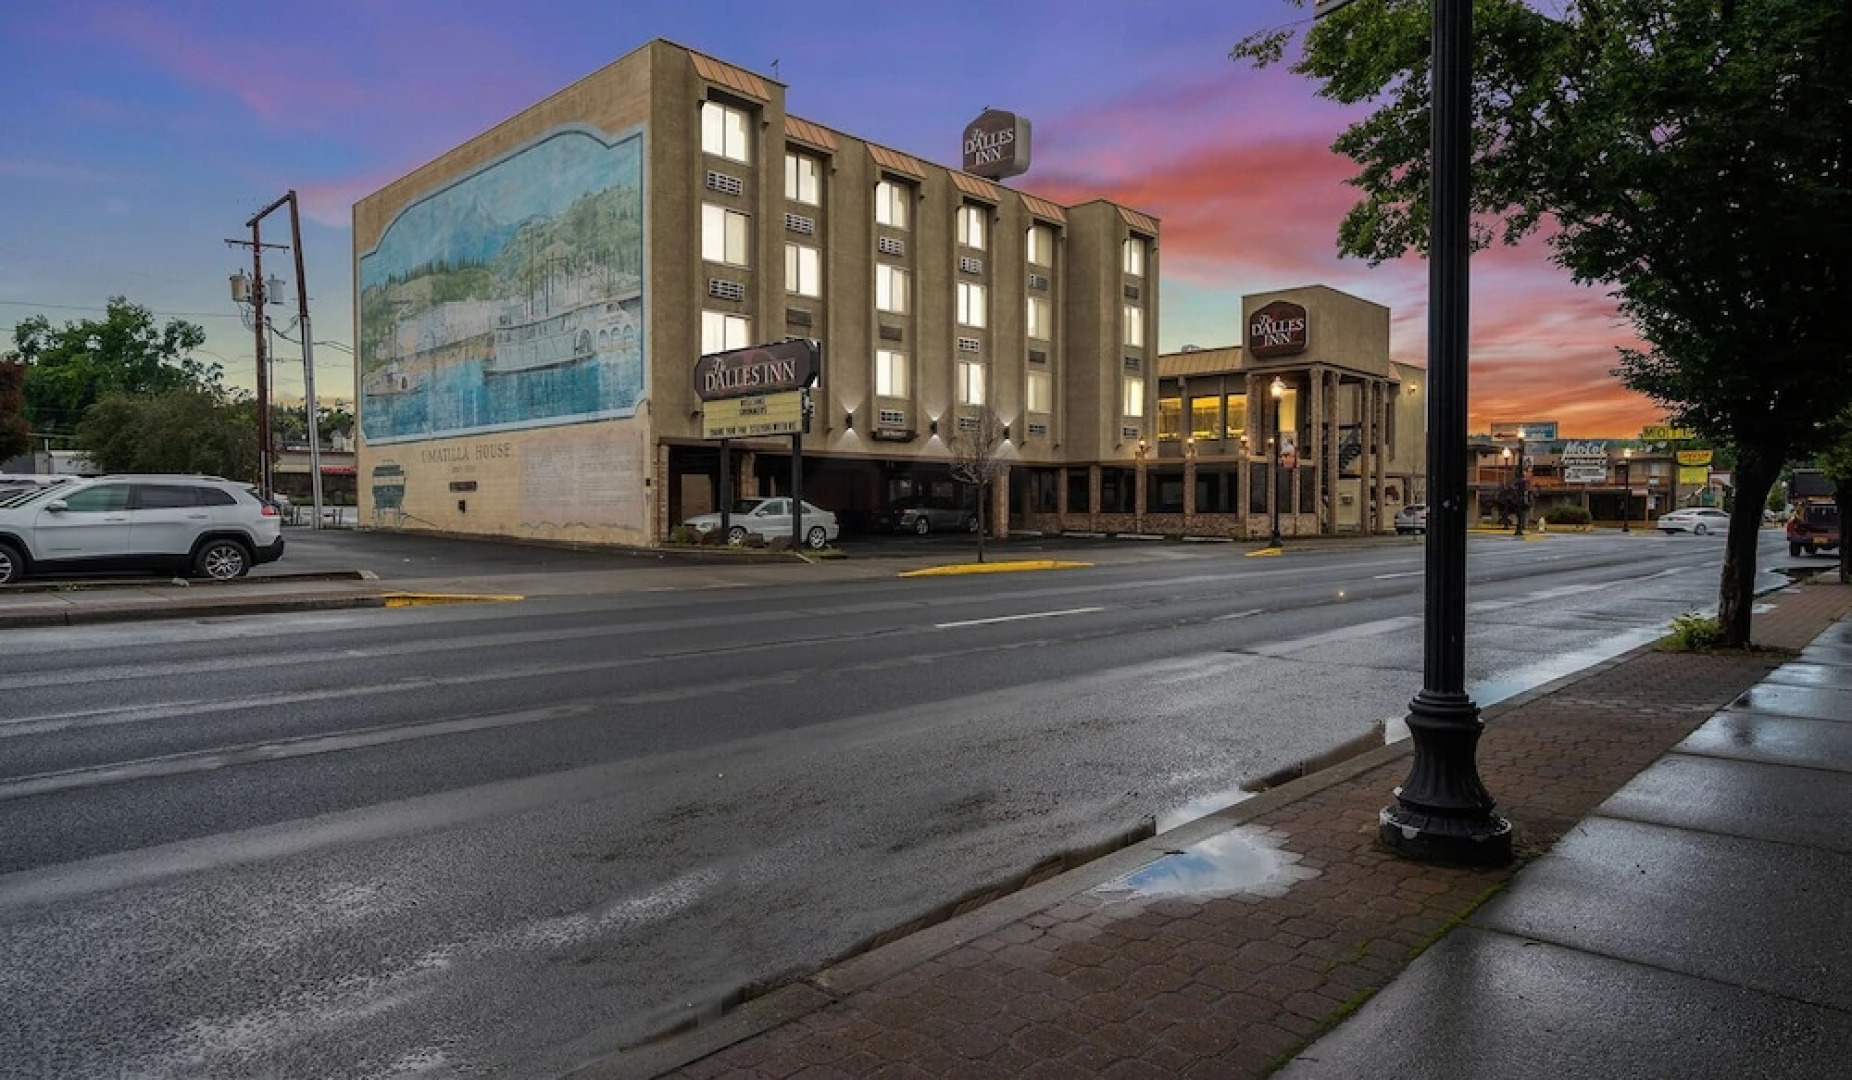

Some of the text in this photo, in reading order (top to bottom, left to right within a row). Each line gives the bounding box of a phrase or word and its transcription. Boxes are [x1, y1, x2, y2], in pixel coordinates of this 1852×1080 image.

[965, 128, 1014, 154] DALLES
[975, 146, 1001, 166] INN
[1251, 318, 1305, 336] DALLES
[1264, 332, 1290, 347] INN
[704, 360, 796, 392] DALLES INN
[475, 442, 511, 461] HOUSE
